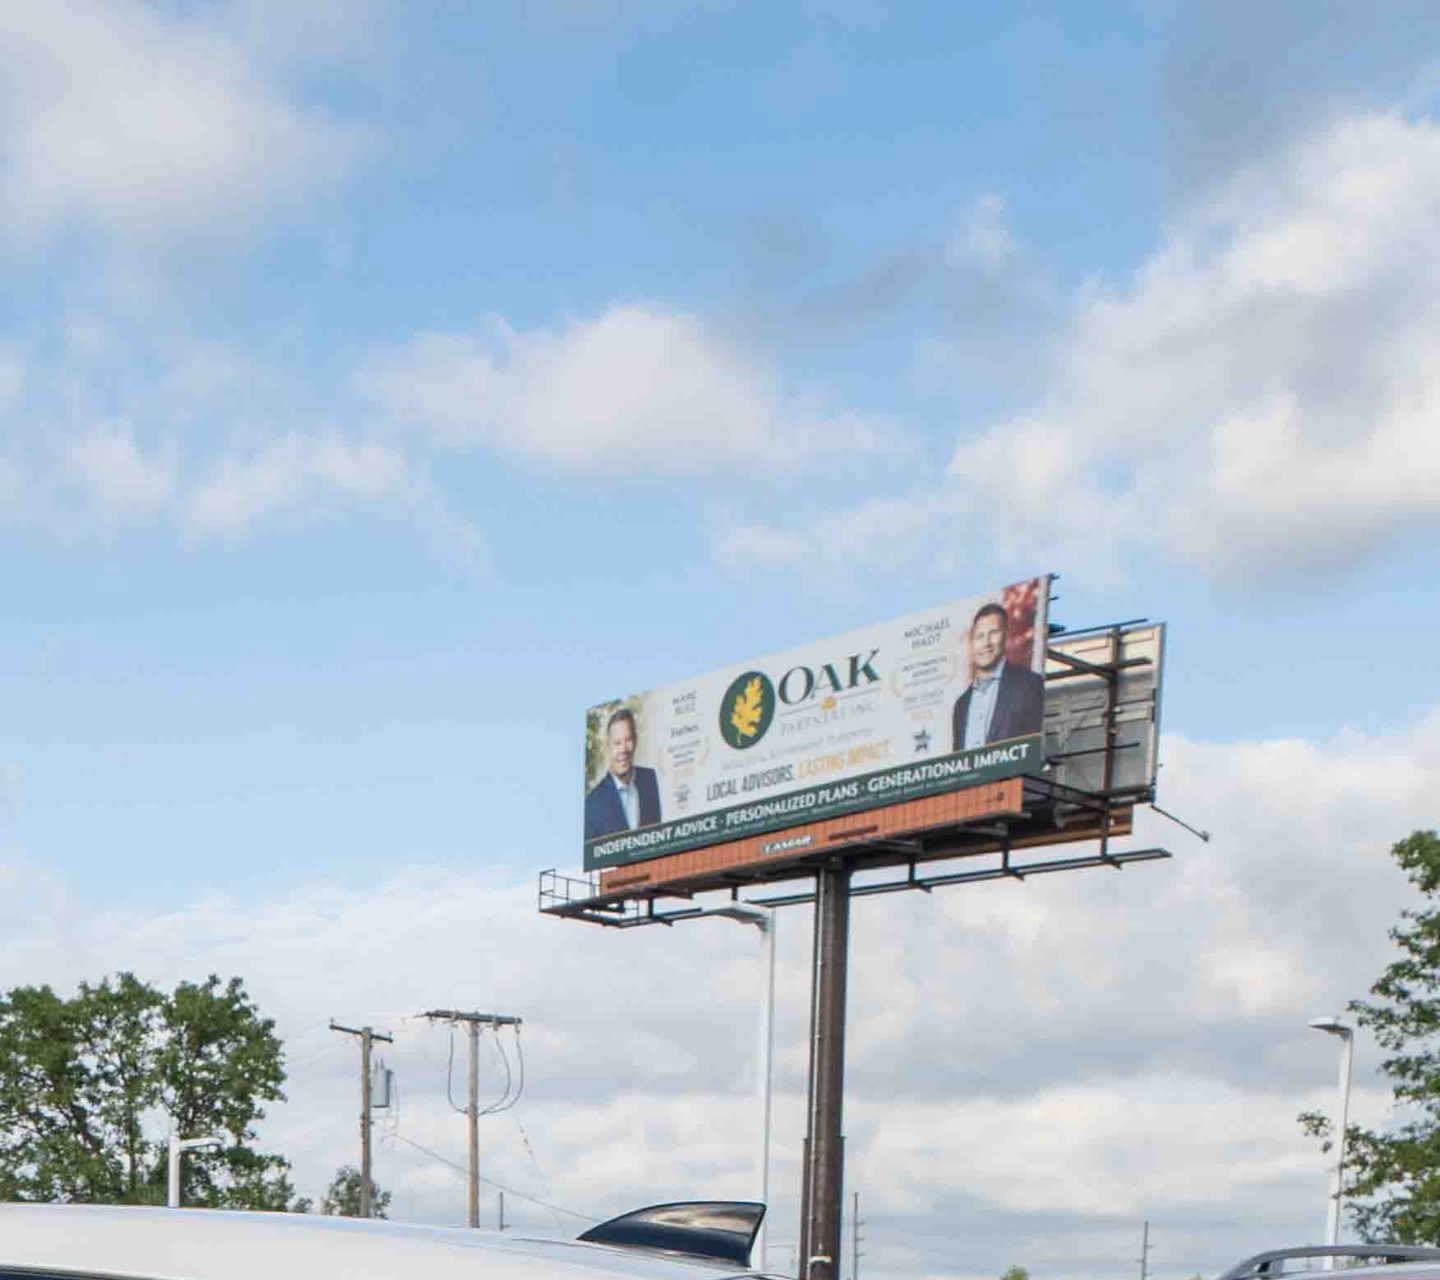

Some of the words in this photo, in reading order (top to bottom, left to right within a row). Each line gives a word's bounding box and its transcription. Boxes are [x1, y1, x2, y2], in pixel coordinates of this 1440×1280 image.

[904, 617, 951, 638] MICHAEL
[778, 647, 881, 705] OAK
[592, 827, 672, 859] INDEPENDENT
[674, 815, 718, 839] ADVICE
[725, 793, 816, 827] PERSONALIZED
[817, 782, 859, 805] PLANS
[866, 760, 972, 793] GENERATIONAL
[973, 742, 1031, 769] IMPACT
[705, 780, 738, 802] LOCAL
[796, 751, 843, 778] LASTING
